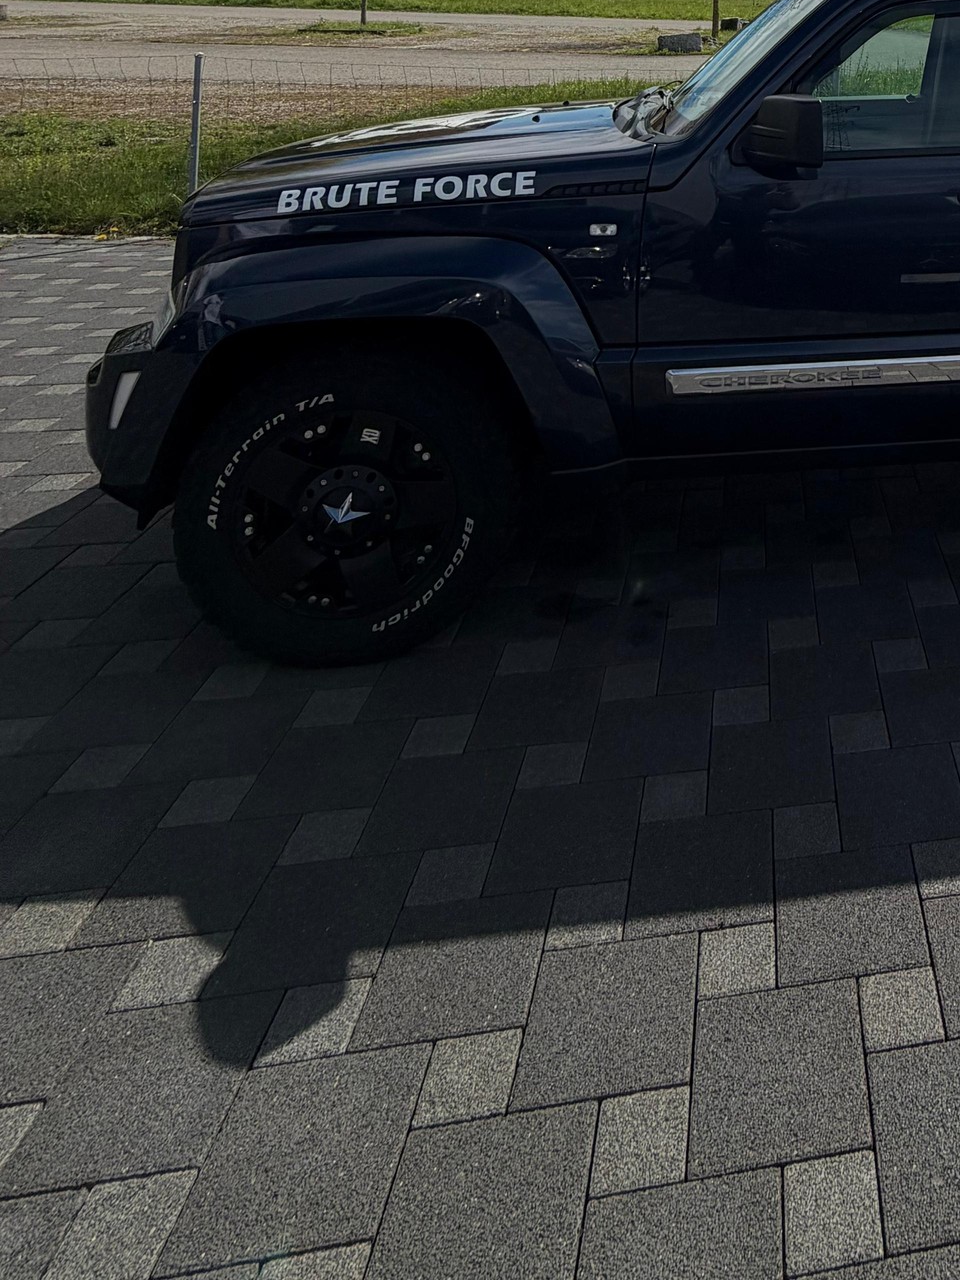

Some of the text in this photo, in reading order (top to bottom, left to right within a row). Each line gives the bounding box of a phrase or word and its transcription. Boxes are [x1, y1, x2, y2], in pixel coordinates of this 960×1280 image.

[277, 171, 536, 214] BRUTE FORCE
[699, 370, 882, 388] CHEROKEE
[206, 393, 335, 530] All-Terrain T/A
[372, 517, 475, 632] BFGoodrich
